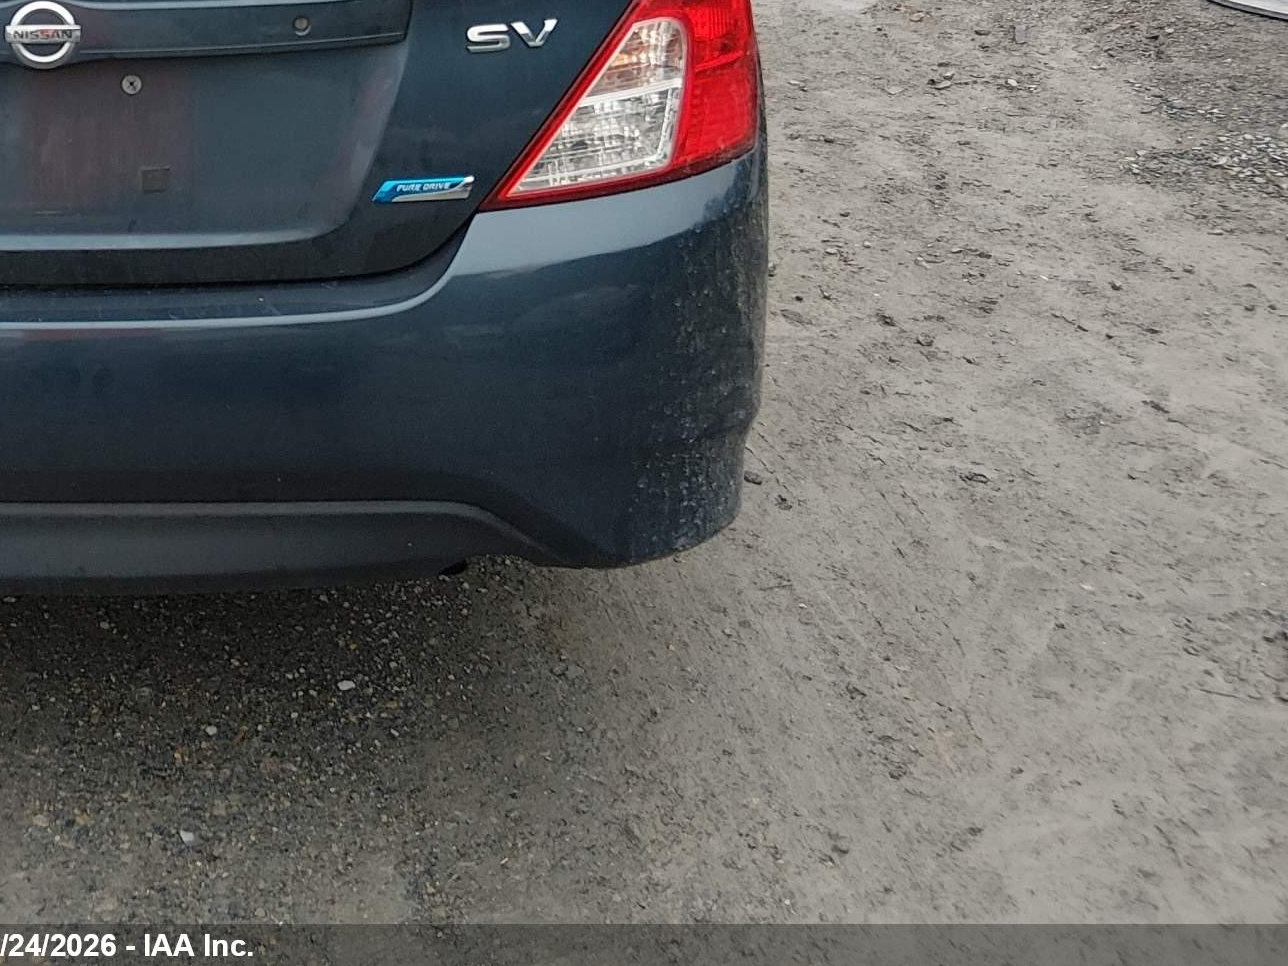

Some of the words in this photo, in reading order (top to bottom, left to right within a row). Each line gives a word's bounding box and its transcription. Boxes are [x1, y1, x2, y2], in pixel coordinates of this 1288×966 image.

[13, 29, 73, 41] NISSAN
[466, 18, 558, 53] SV
[396, 184, 421, 192] PURE
[422, 182, 452, 191] DRIVE
